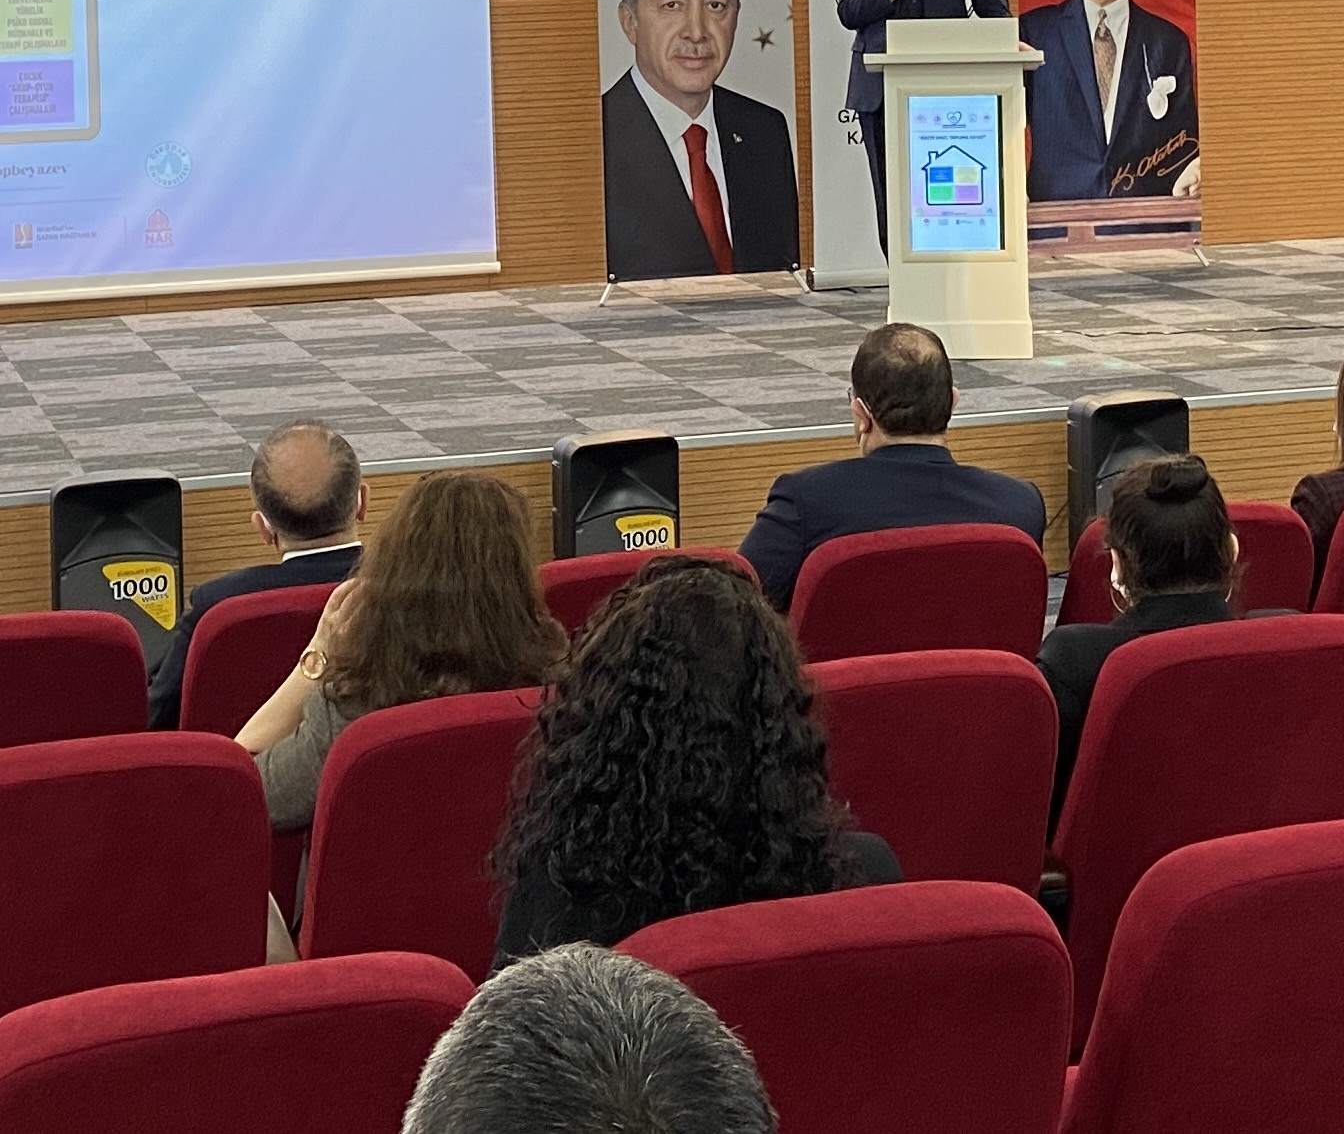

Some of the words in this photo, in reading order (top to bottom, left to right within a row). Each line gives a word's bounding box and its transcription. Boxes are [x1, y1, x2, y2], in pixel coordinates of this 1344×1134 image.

[622, 527, 668, 548] 1000
[112, 574, 168, 599] 1000
[141, 593, 169, 603] WATTS
